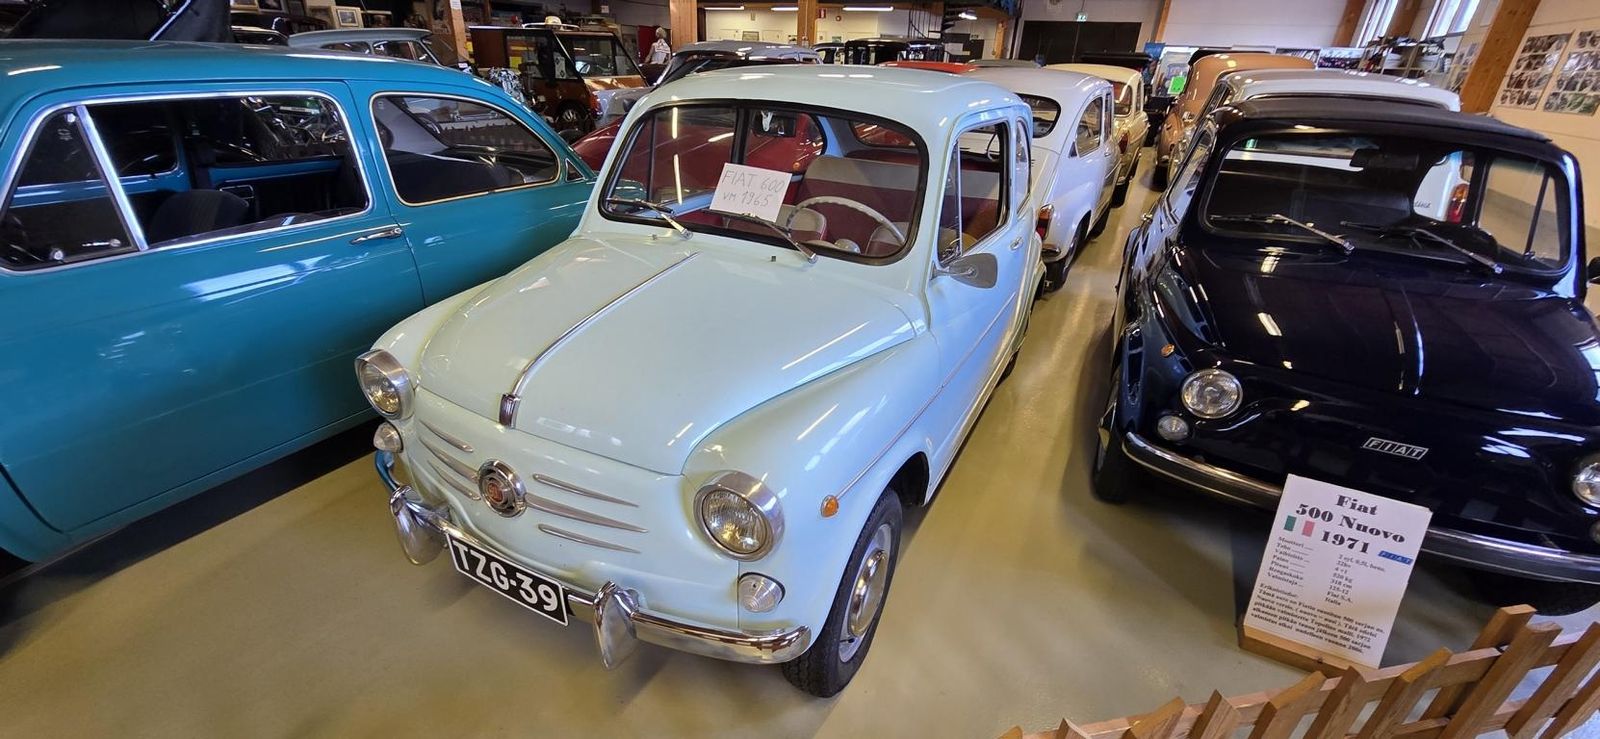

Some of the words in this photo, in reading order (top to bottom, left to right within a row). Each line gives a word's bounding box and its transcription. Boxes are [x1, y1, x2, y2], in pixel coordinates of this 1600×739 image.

[722, 169, 758, 188] FIAT
[760, 177, 785, 193] 600
[741, 191, 772, 206] 1965
[1367, 439, 1424, 457] FIAT
[1336, 495, 1378, 515] Fiat
[1296, 503, 1333, 522] 500
[1339, 515, 1406, 543] Nuovo
[1321, 531, 1370, 553] 1971
[1378, 551, 1412, 564] FIAT
[453, 540, 558, 611] TZG-39
